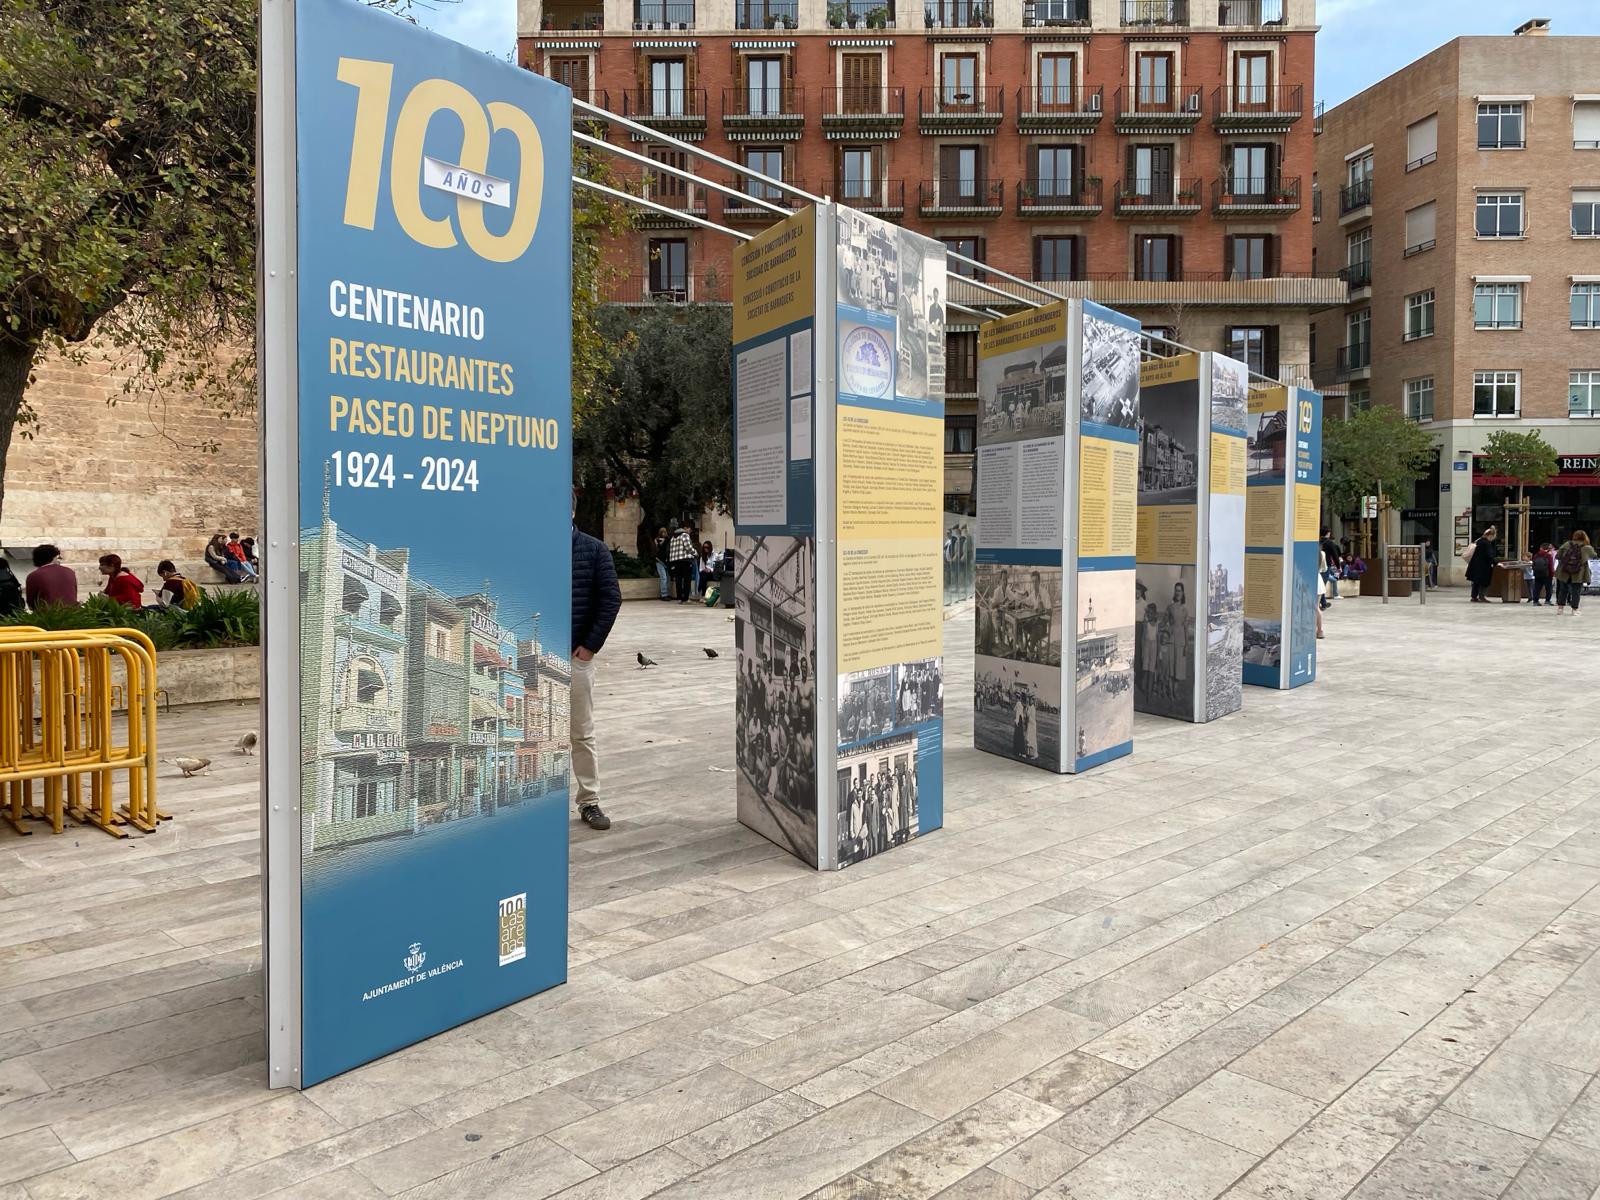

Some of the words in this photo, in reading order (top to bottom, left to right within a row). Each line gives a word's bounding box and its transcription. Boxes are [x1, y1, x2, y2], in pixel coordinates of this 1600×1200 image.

[336, 56, 544, 263] 100
[443, 170, 494, 199] AÑOS
[329, 279, 485, 341] CENTENARIO
[330, 337, 514, 396] RESTAURANTES
[330, 395, 414, 439] PASEO
[422, 406, 453, 442] DE
[461, 411, 559, 450] NEPTUNO
[331, 450, 395, 488] 1924
[420, 456, 479, 492] 2024
[1563, 458, 1600, 469] REIN
[362, 976, 415, 1001] AJUNTAMENT
[417, 973, 426, 982] DE
[428, 959, 464, 978] VALÈNCIA
